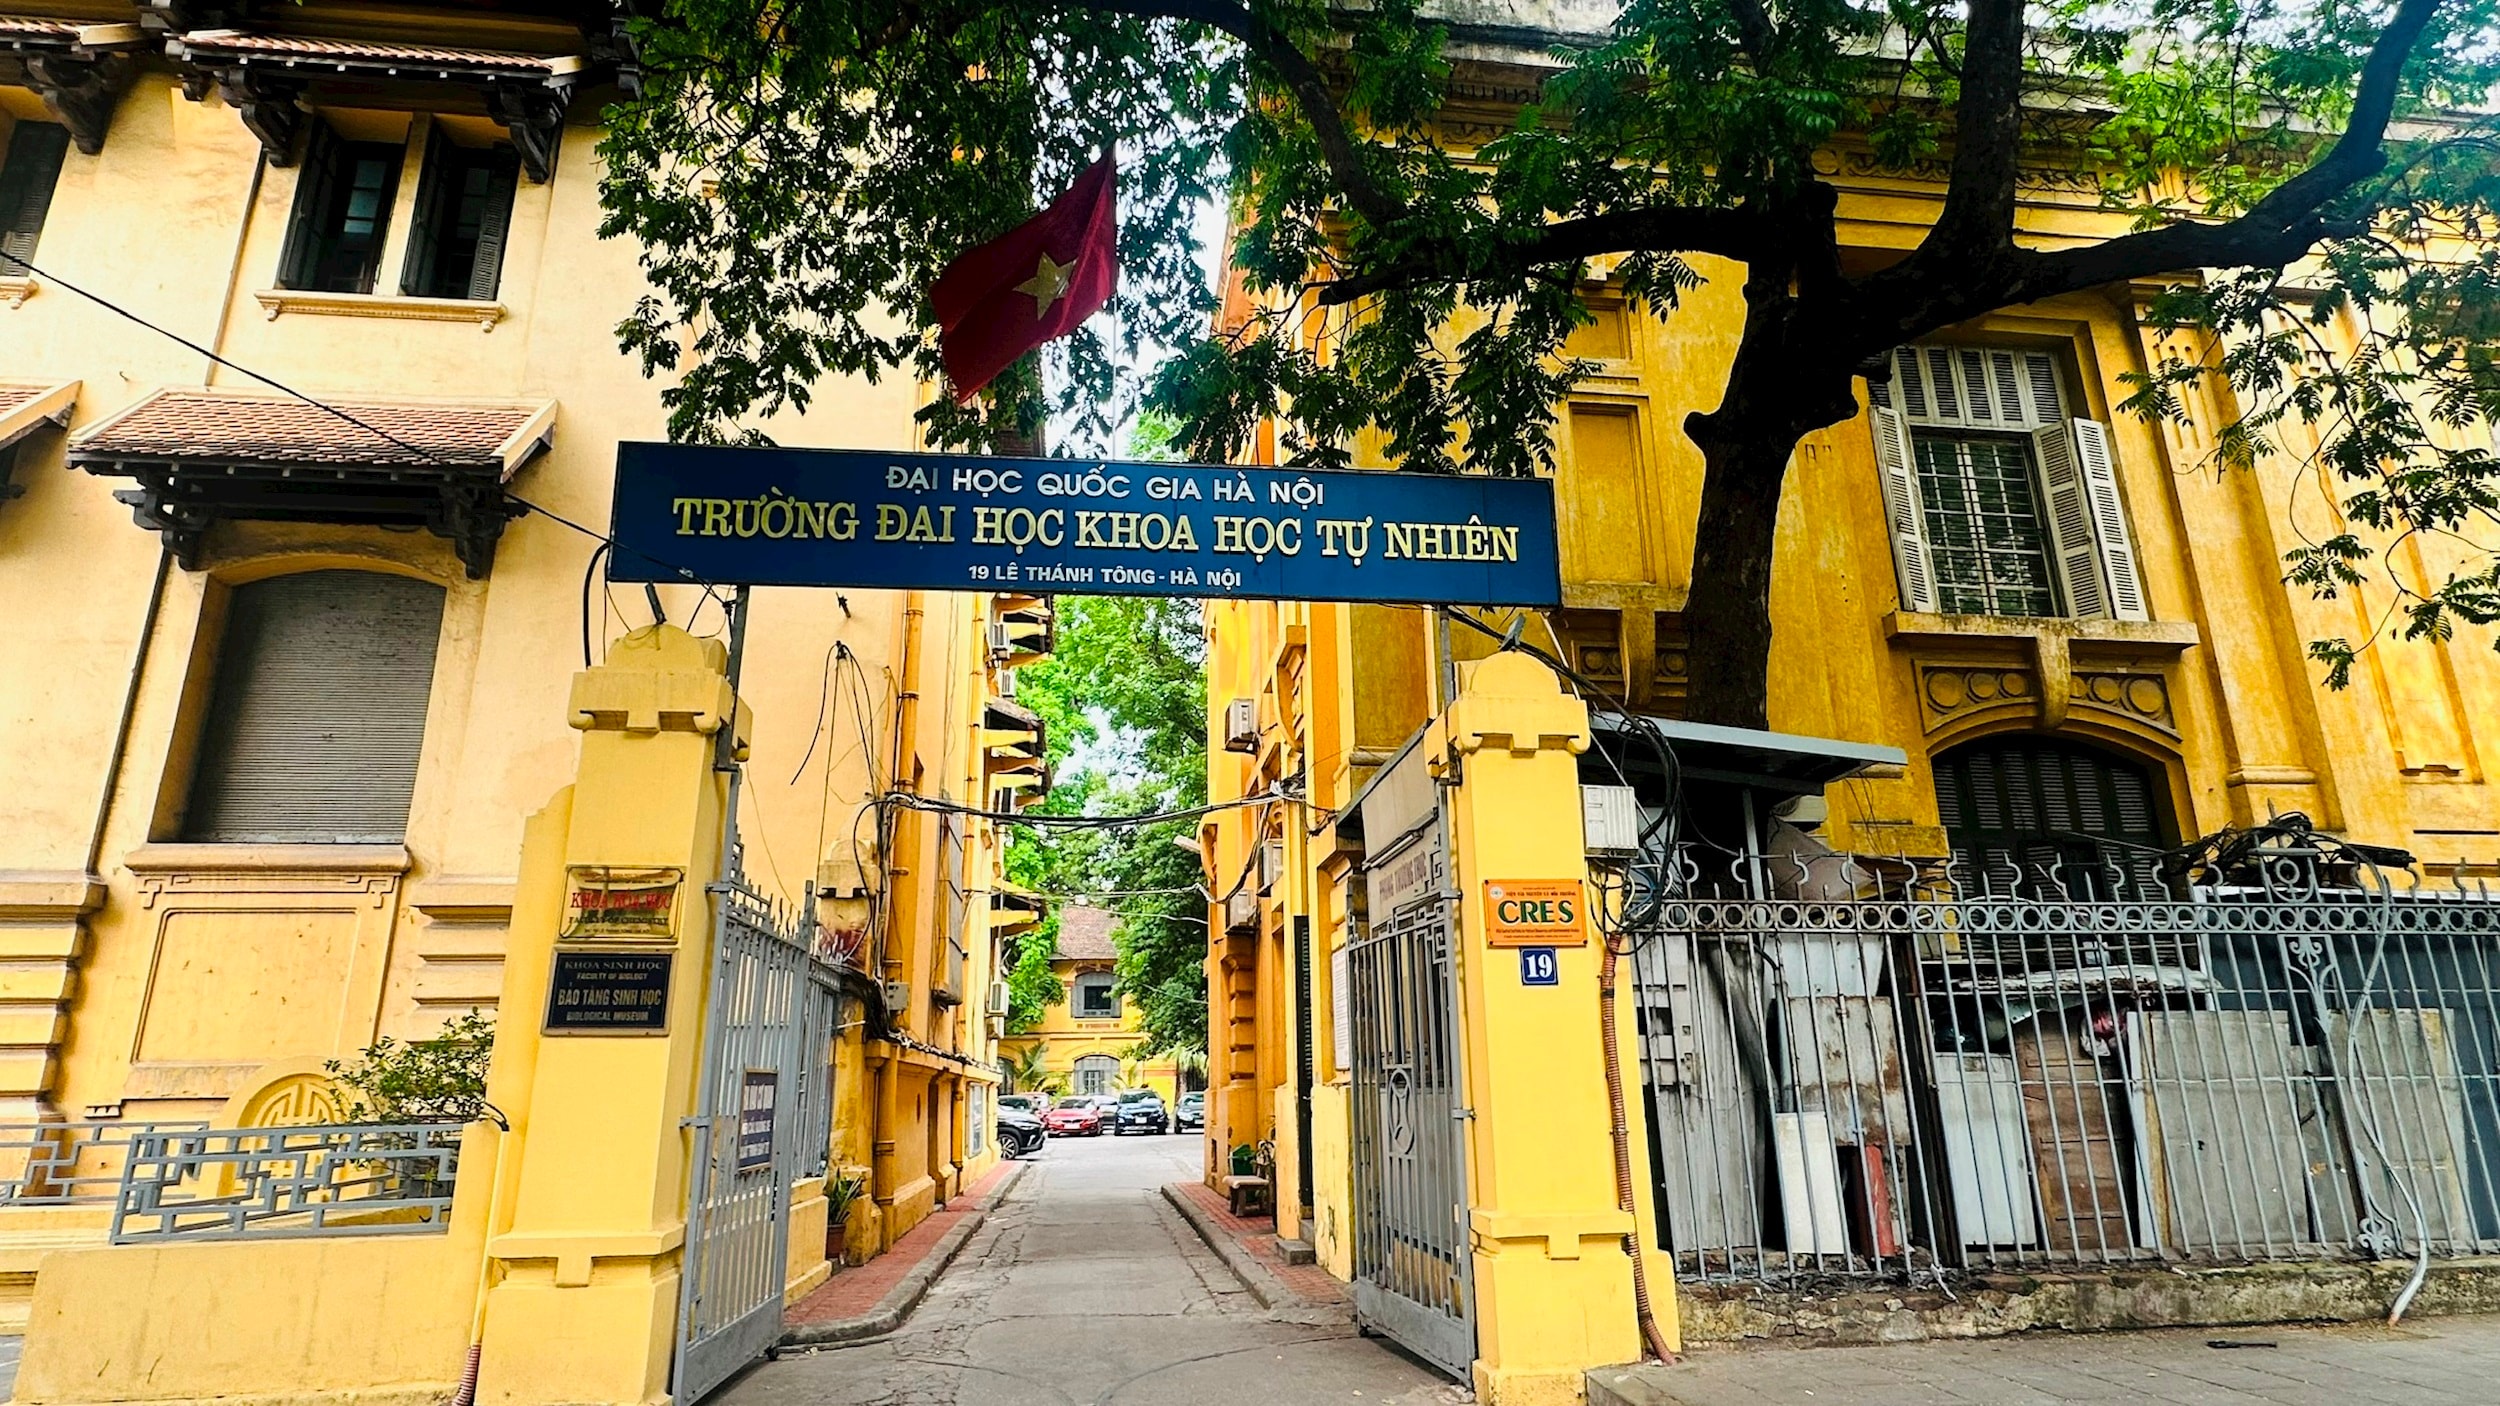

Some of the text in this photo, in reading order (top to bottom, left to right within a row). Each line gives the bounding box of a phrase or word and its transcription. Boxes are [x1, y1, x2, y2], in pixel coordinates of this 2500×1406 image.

[885, 464, 1324, 510] ĐẠI HỌC QUỐC GIA HÀ NỘI
[673, 486, 860, 540] TRƯỜNG
[972, 507, 1065, 554] HỌC
[1074, 511, 1200, 551] KHOA
[1213, 516, 1302, 564] HỌC
[1316, 515, 1374, 567] TỰ
[1383, 515, 1519, 562] NHIÊN
[968, 565, 990, 580] 19
[995, 562, 1019, 581] LÊ
[1025, 563, 1094, 582] THÁNH
[1101, 565, 1156, 584] TÔNG
[1170, 566, 1199, 585] HÀ
[1206, 568, 1241, 591] NỘI
[1498, 900, 1574, 923] CRES
[564, 961, 664, 971] KHOA SINH HỌC
[576, 972, 606, 980] FACULTY
[1525, 954, 1553, 978] 19
[612, 989, 639, 1006] SINH
[639, 989, 662, 1010] HỌC
[566, 1011, 649, 1021] BIOLOGICAL MUSEUM
